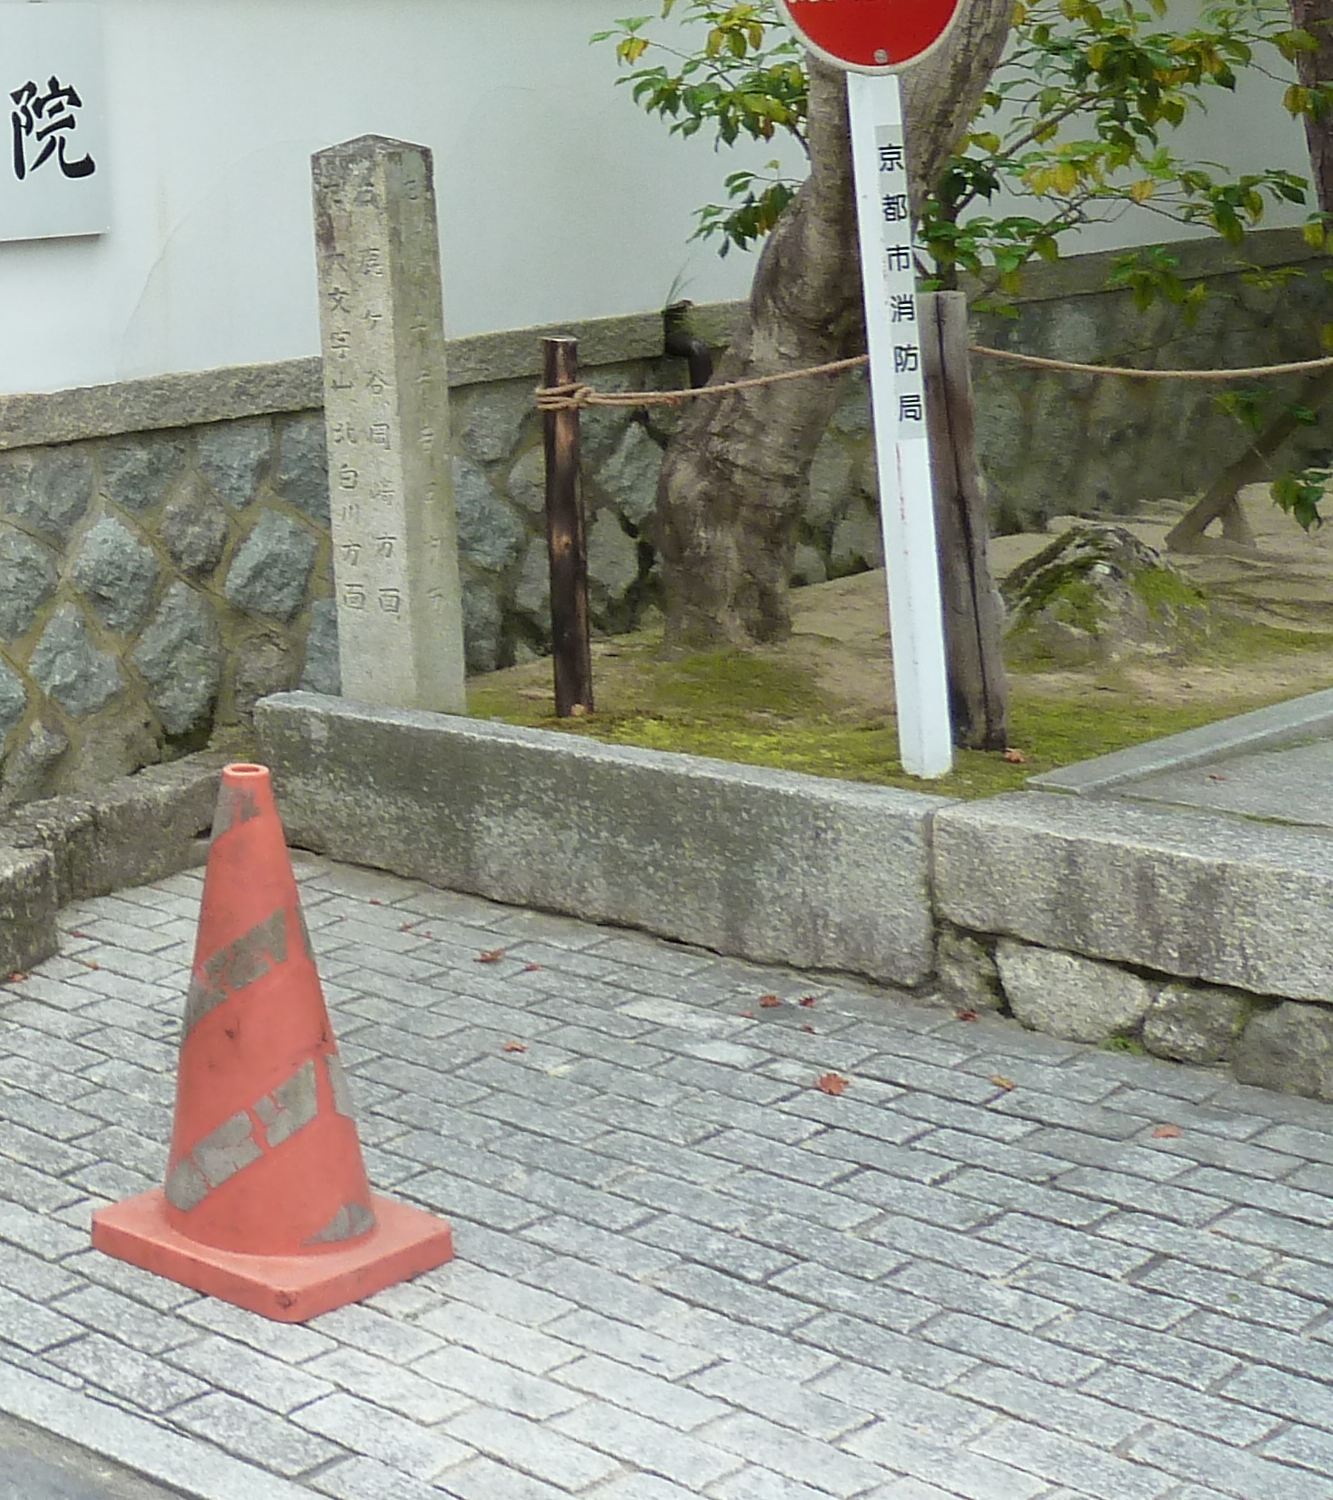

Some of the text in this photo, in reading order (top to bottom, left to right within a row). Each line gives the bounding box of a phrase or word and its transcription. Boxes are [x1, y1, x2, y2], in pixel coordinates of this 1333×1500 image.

[878, 143, 924, 423] 京都市消防局
